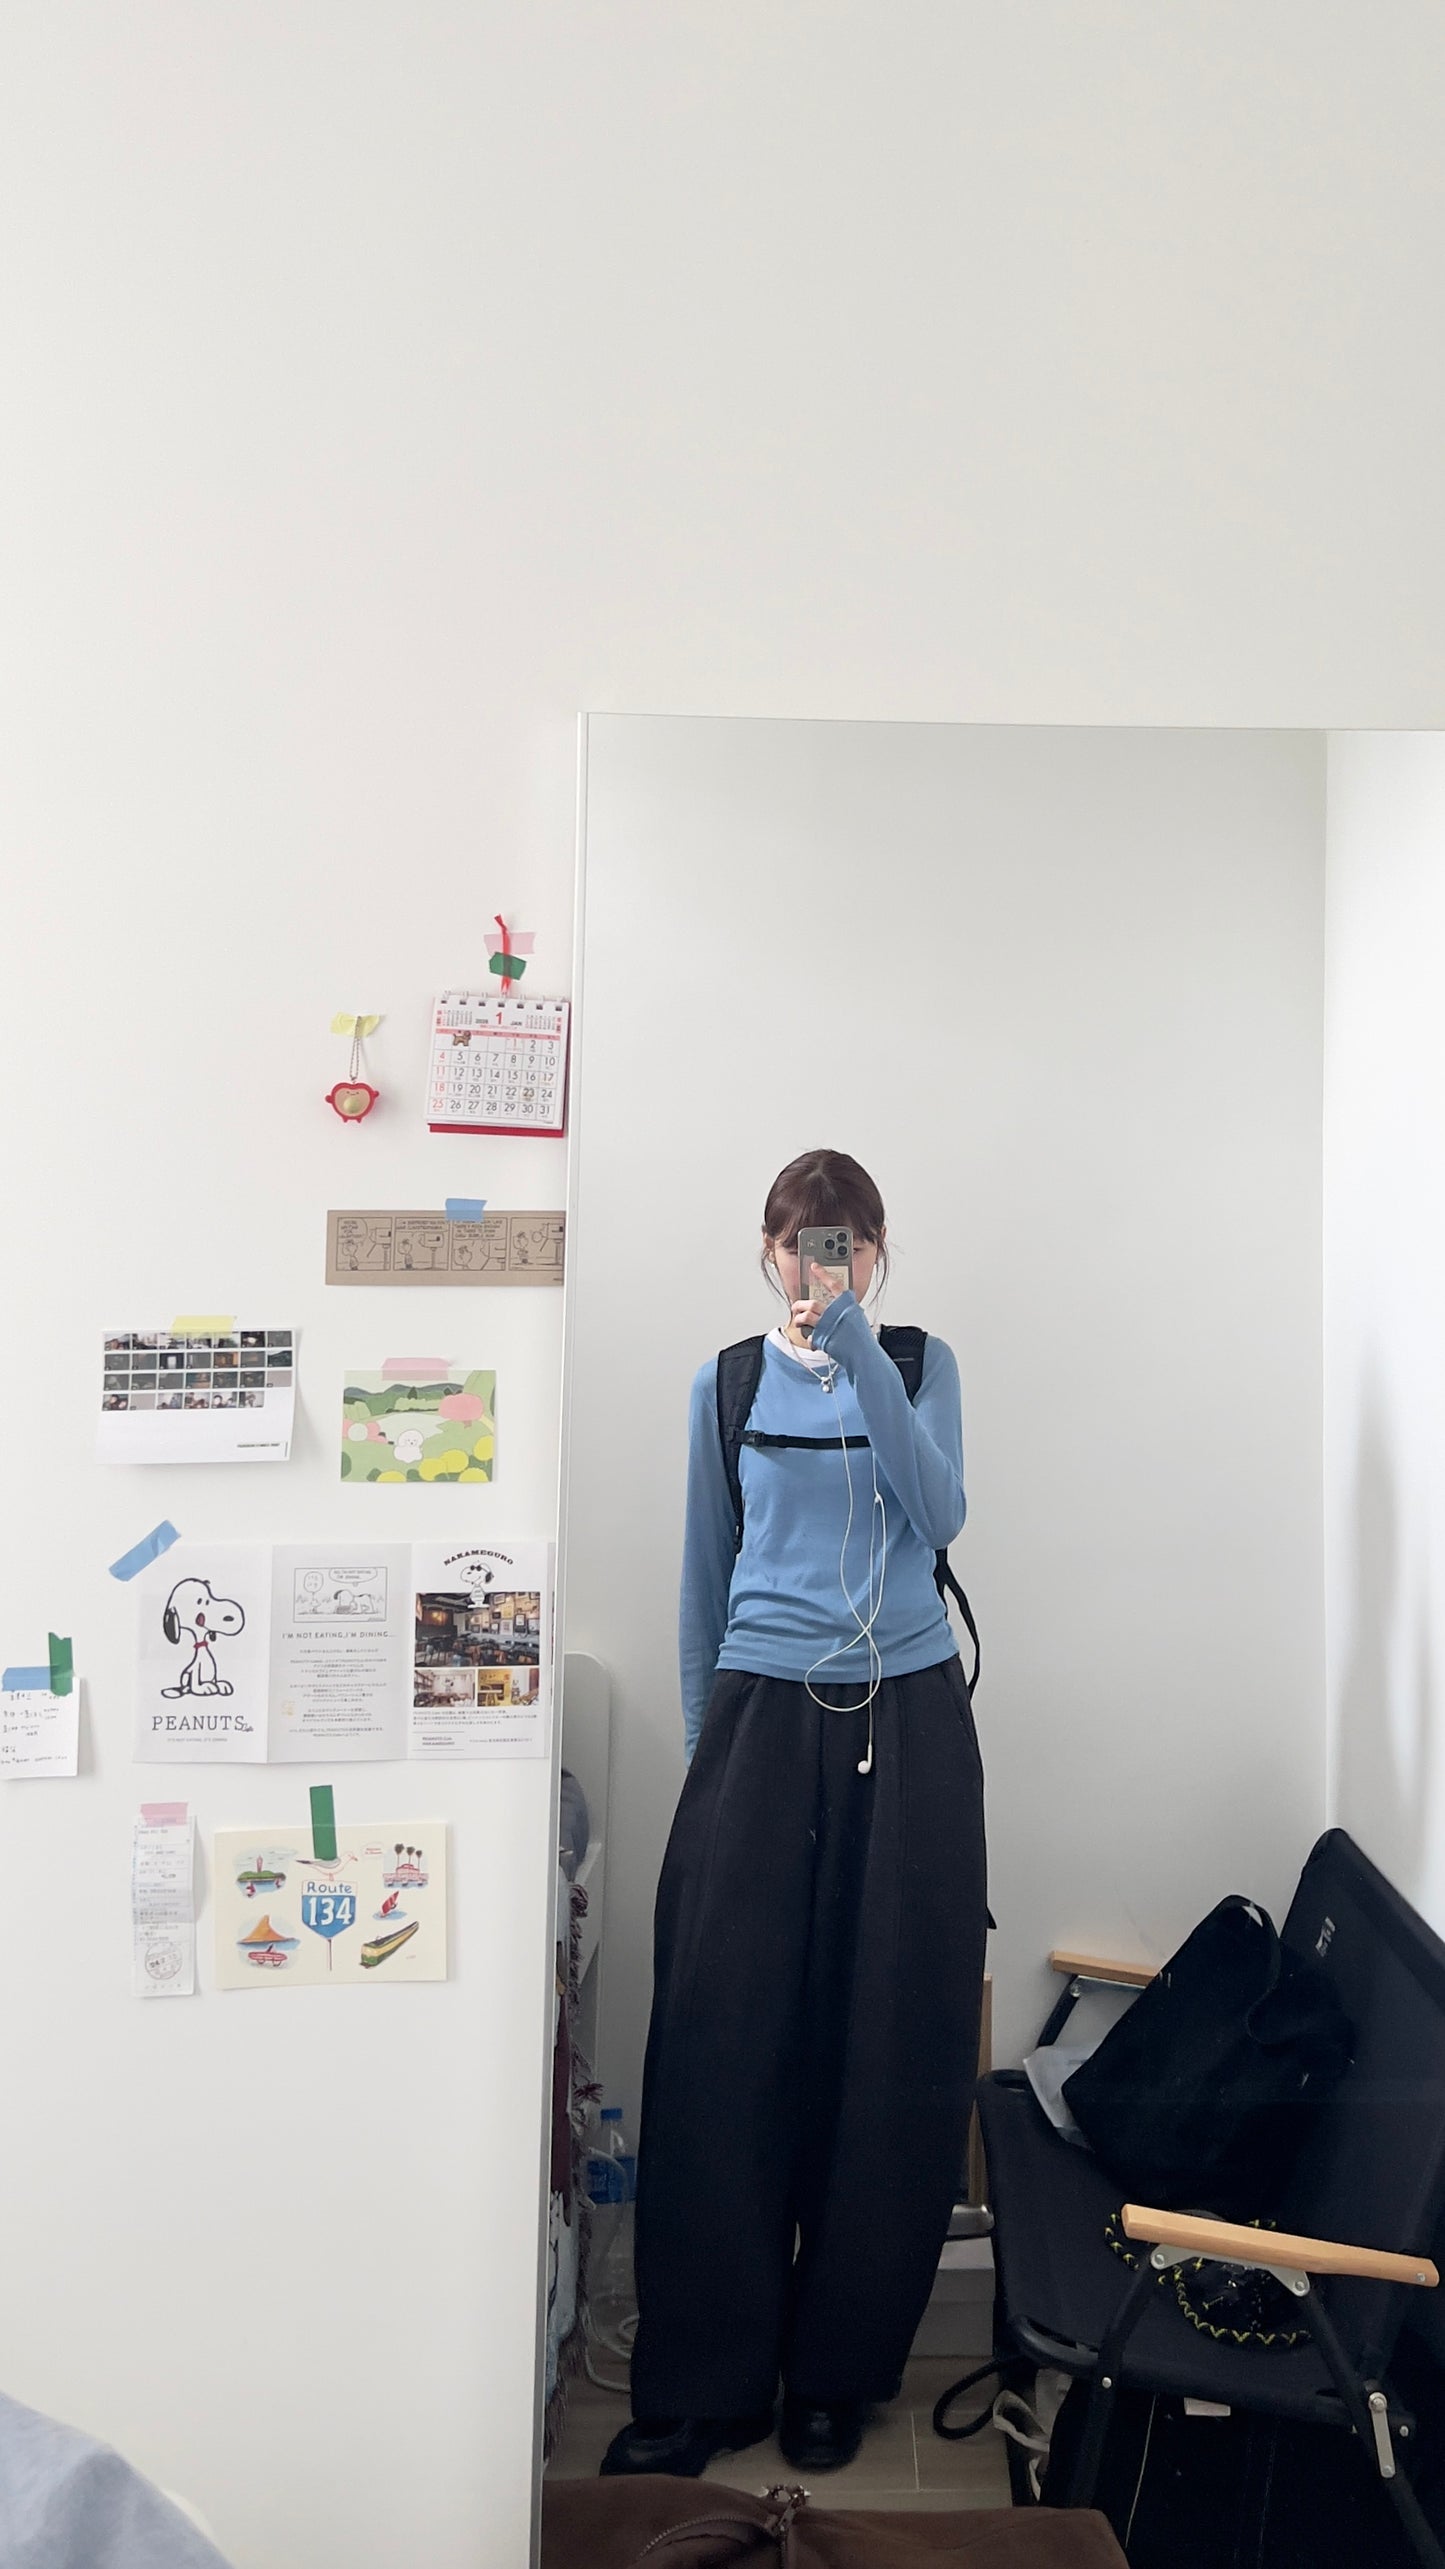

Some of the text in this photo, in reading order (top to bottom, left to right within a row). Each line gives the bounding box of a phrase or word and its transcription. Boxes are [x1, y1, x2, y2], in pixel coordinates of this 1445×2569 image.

[495, 1011, 502, 1025] 1
[530, 1040, 536, 1049] 2
[549, 1041, 554, 1050] 3
[439, 1051, 556, 1066] 4 5 6 7 8 9 10
[436, 1066, 554, 1082] 11 12 13 14 15 16 17
[434, 1082, 553, 1098] 18 19 20 21 22 23 24
[433, 1099, 550, 1114] 25 26 27 28 29 30 31
[443, 1549, 514, 1566] NAKAMEGURO
[152, 1715, 244, 1731] PEANUTS
[307, 1881, 352, 1893] Route
[308, 1897, 352, 1926] 134
